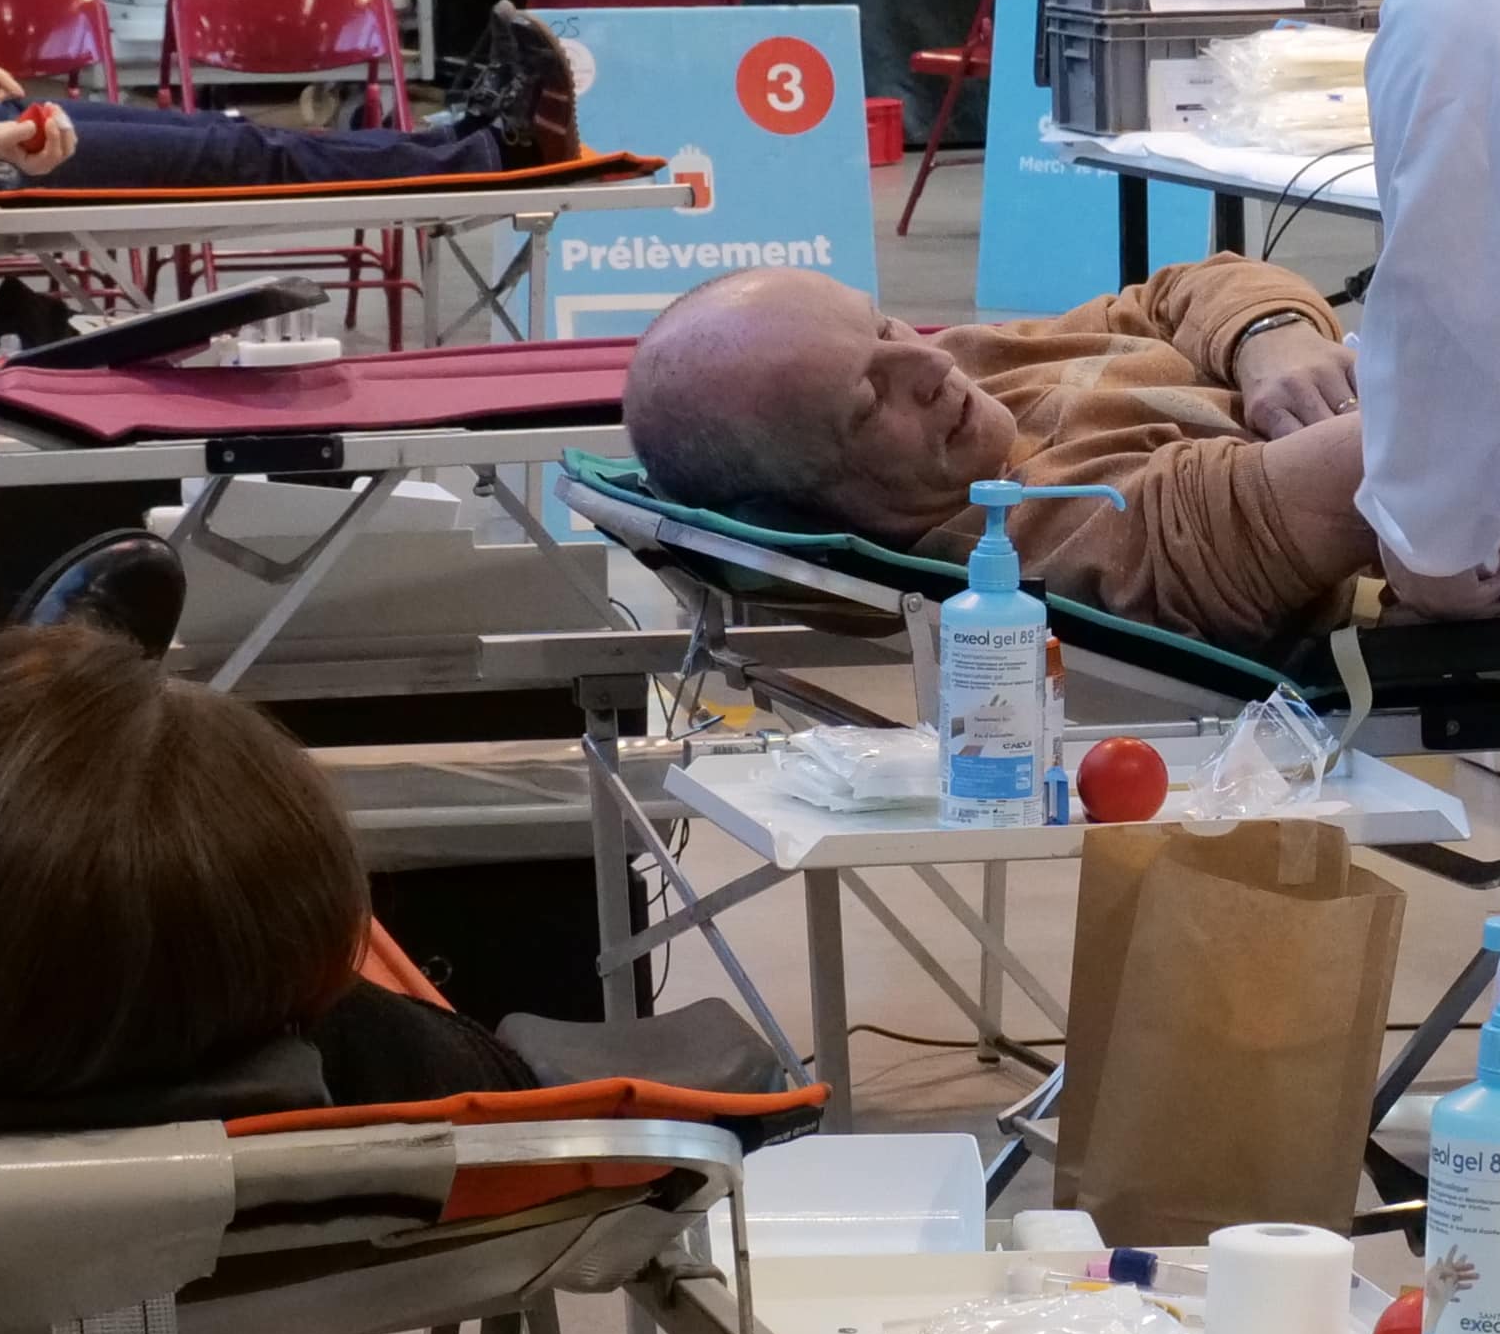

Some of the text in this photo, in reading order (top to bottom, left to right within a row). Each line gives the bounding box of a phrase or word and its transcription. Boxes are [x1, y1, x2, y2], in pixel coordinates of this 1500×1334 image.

[766, 62, 805, 113] 3
[561, 234, 833, 271] Prélèvement
[953, 630, 990, 646] exeol
[993, 632, 1016, 649] gel
[1432, 1142, 1450, 1167] eol
[1453, 1152, 1483, 1175] gel
